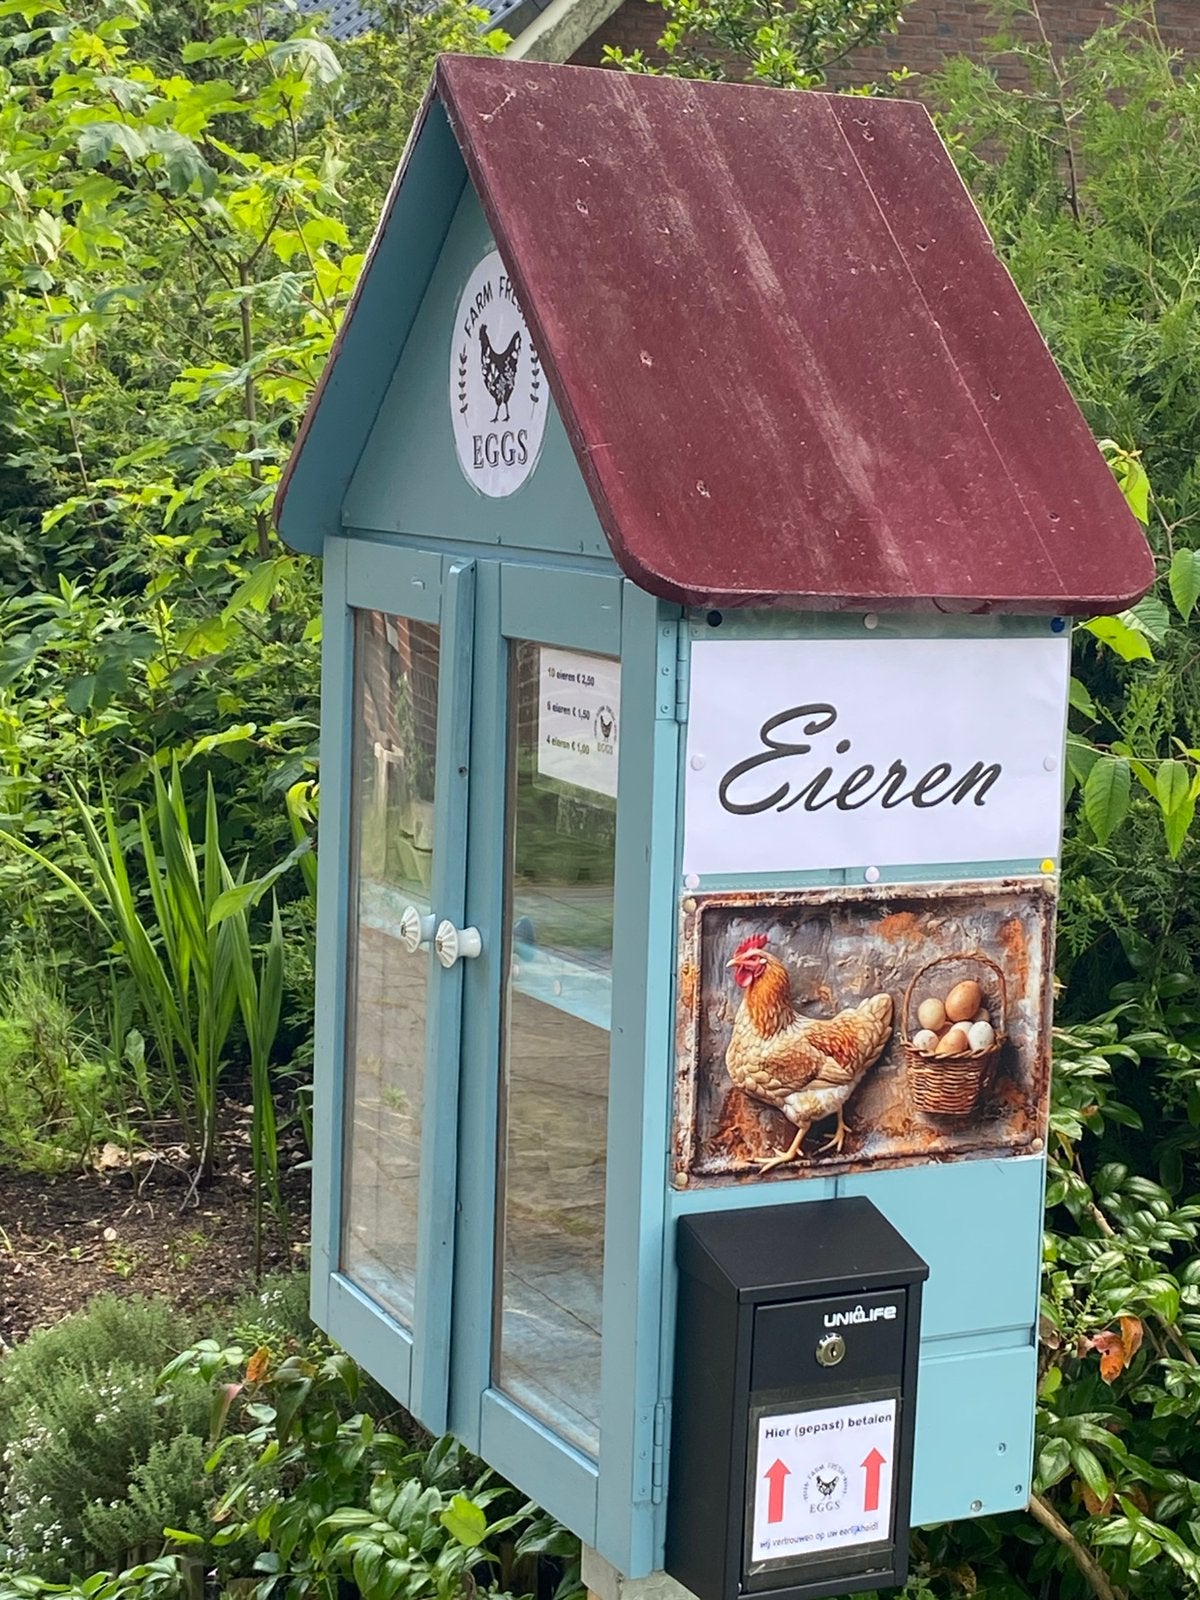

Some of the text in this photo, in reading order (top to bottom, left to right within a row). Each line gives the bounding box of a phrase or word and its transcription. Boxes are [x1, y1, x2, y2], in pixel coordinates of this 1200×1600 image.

[464, 280, 494, 339] FARM
[472, 428, 528, 469] EGGS
[548, 667, 555, 678] 10
[556, 671, 575, 682] eieren
[581, 674, 595, 687] 2,50
[552, 702, 571, 716] eieren
[578, 708, 591, 721] 1,50
[546, 734, 551, 744] 4
[551, 737, 570, 750] eieren
[577, 742, 590, 755] 1,00
[718, 702, 1003, 816] Eieren
[764, 1412, 893, 1440] Hier (gepast) betalen
[810, 1500, 841, 1514] EGGS
[759, 1538, 771, 1549] wij
[772, 1532, 814, 1547] vertrouwen
[815, 1531, 825, 1541] op
[827, 1530, 838, 1538] uw
